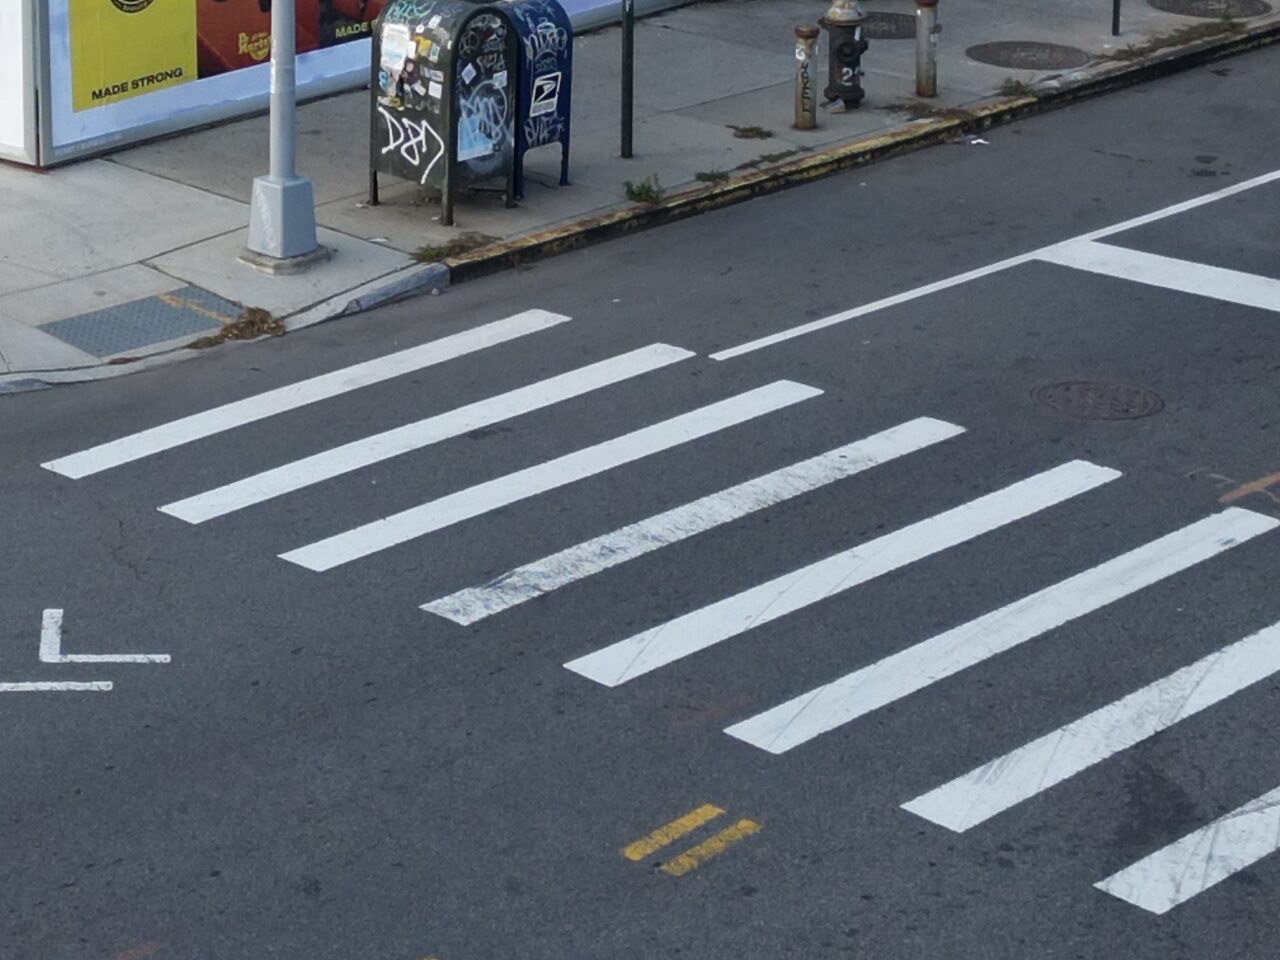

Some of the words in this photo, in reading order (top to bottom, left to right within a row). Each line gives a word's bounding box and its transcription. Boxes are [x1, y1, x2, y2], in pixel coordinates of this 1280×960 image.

[335, 21, 369, 38] MADE
[91, 81, 128, 100] MADE
[130, 67, 184, 90] STRONG
